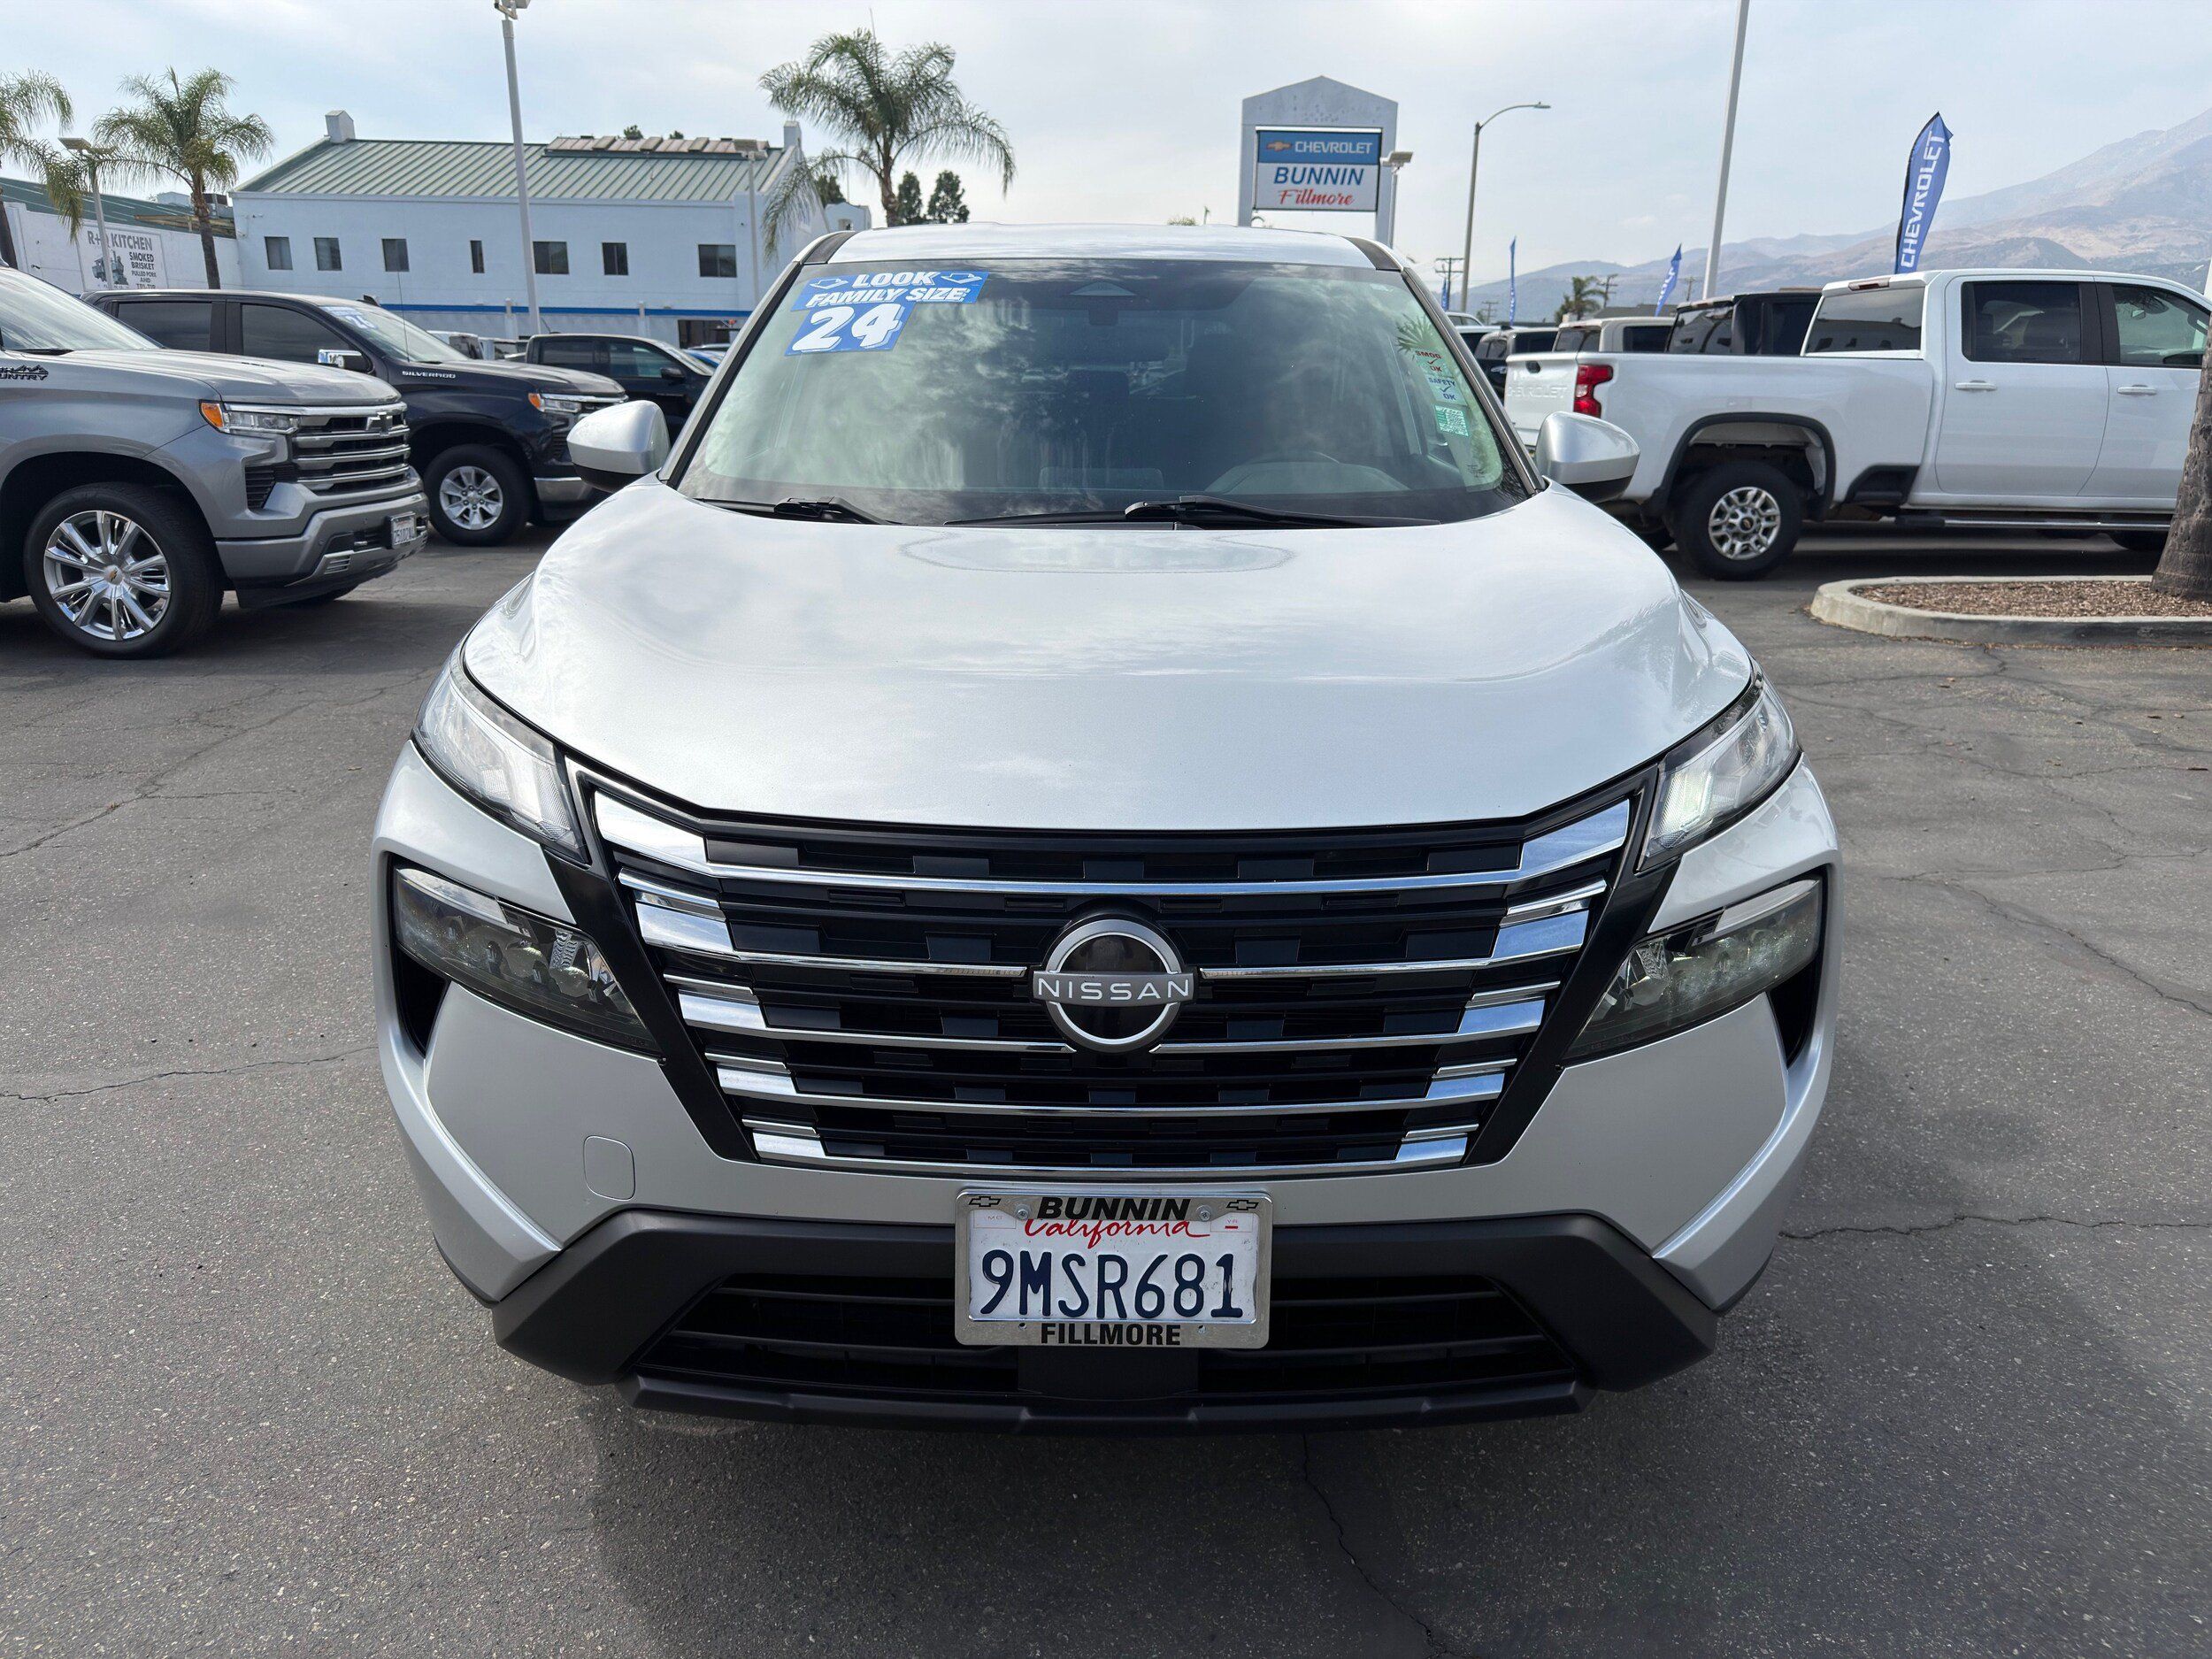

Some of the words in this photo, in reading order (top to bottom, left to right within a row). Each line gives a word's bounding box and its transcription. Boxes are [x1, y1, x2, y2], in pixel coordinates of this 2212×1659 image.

[1294, 141, 1373, 154] CHEVROLET
[1273, 166, 1364, 186] BUNNIN
[1278, 188, 1355, 206] Fillmore
[1901, 130, 1945, 268] CHEVROLET
[111, 233, 153, 251] KITCHEN
[129, 251, 155, 262] SMOKED
[131, 261, 155, 270] BRISKET
[851, 272, 941, 288] LOOK
[806, 288, 908, 308] FAMILY
[905, 287, 971, 303] SIZE
[791, 303, 905, 351] 24
[1415, 350, 1442, 359] SMOG
[1427, 377, 1456, 387] SAFETY
[1038, 978, 1189, 1001] NISSAN
[1036, 1197, 1192, 1220] BUNNIN
[1024, 1218, 1210, 1249] California
[979, 1249, 1244, 1320] 9MSR681
[1041, 1323, 1181, 1346] FILLMORE
